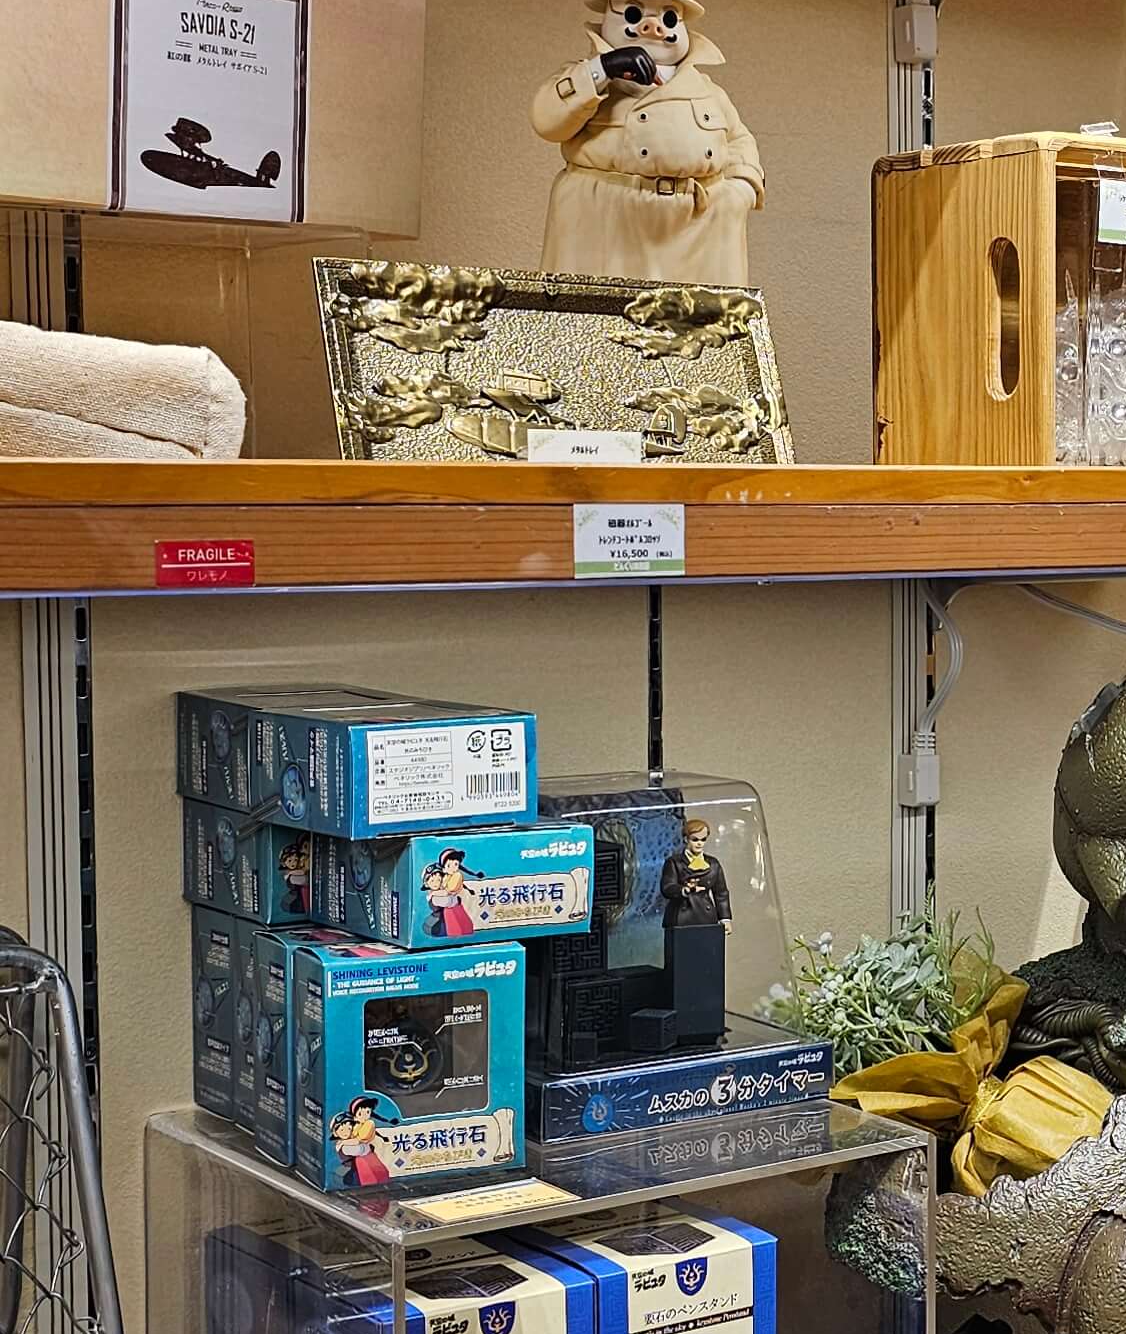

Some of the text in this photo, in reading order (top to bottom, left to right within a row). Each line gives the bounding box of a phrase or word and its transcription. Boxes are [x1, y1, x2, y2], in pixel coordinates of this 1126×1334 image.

[180, 12, 256, 46] SAVOIA S-21
[198, 43, 238, 58] METAL TRAY
[177, 547, 236, 562] FRAGILE
[610, 550, 649, 559] ¥16,500
[186, 570, 228, 582] ワレモノ
[479, 882, 565, 907] 光る飛行石
[333, 963, 429, 980] SHINING LEVISTONE
[392, 1124, 488, 1154] 光る飛行石
[634, 1274, 667, 1292] ラピュタ
